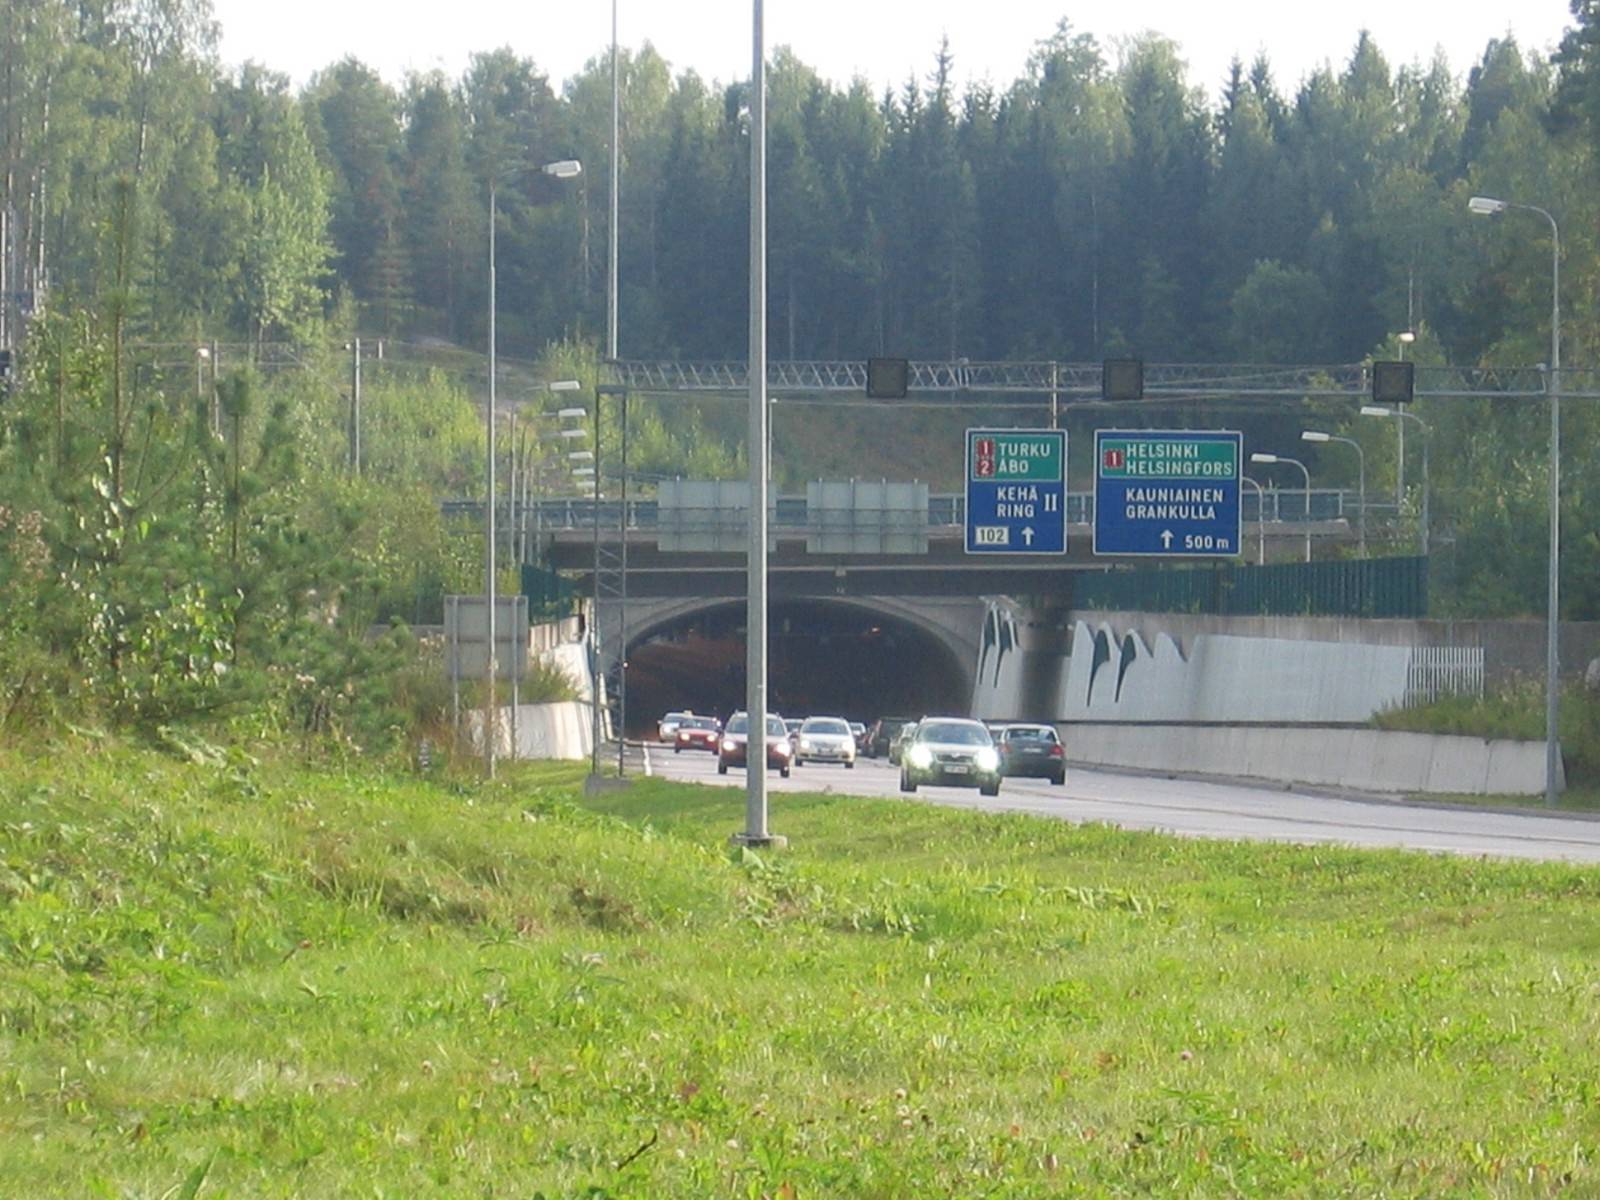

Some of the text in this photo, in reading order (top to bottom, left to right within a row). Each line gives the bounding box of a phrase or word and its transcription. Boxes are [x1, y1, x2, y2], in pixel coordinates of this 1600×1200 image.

[999, 443, 1051, 456] TURKU
[1126, 444, 1199, 457] HELSINKI
[981, 462, 989, 474] 2
[999, 458, 1029, 473] ÅBO
[1126, 461, 1232, 475] HELSINGFORS
[997, 486, 1038, 501] KEHÄ
[1126, 489, 1223, 502] KAUNIAINEN
[997, 505, 1035, 517] RING
[1126, 506, 1216, 519] GRANKULLA
[980, 529, 1004, 542] 102
[1185, 536, 1229, 548] 500 m
